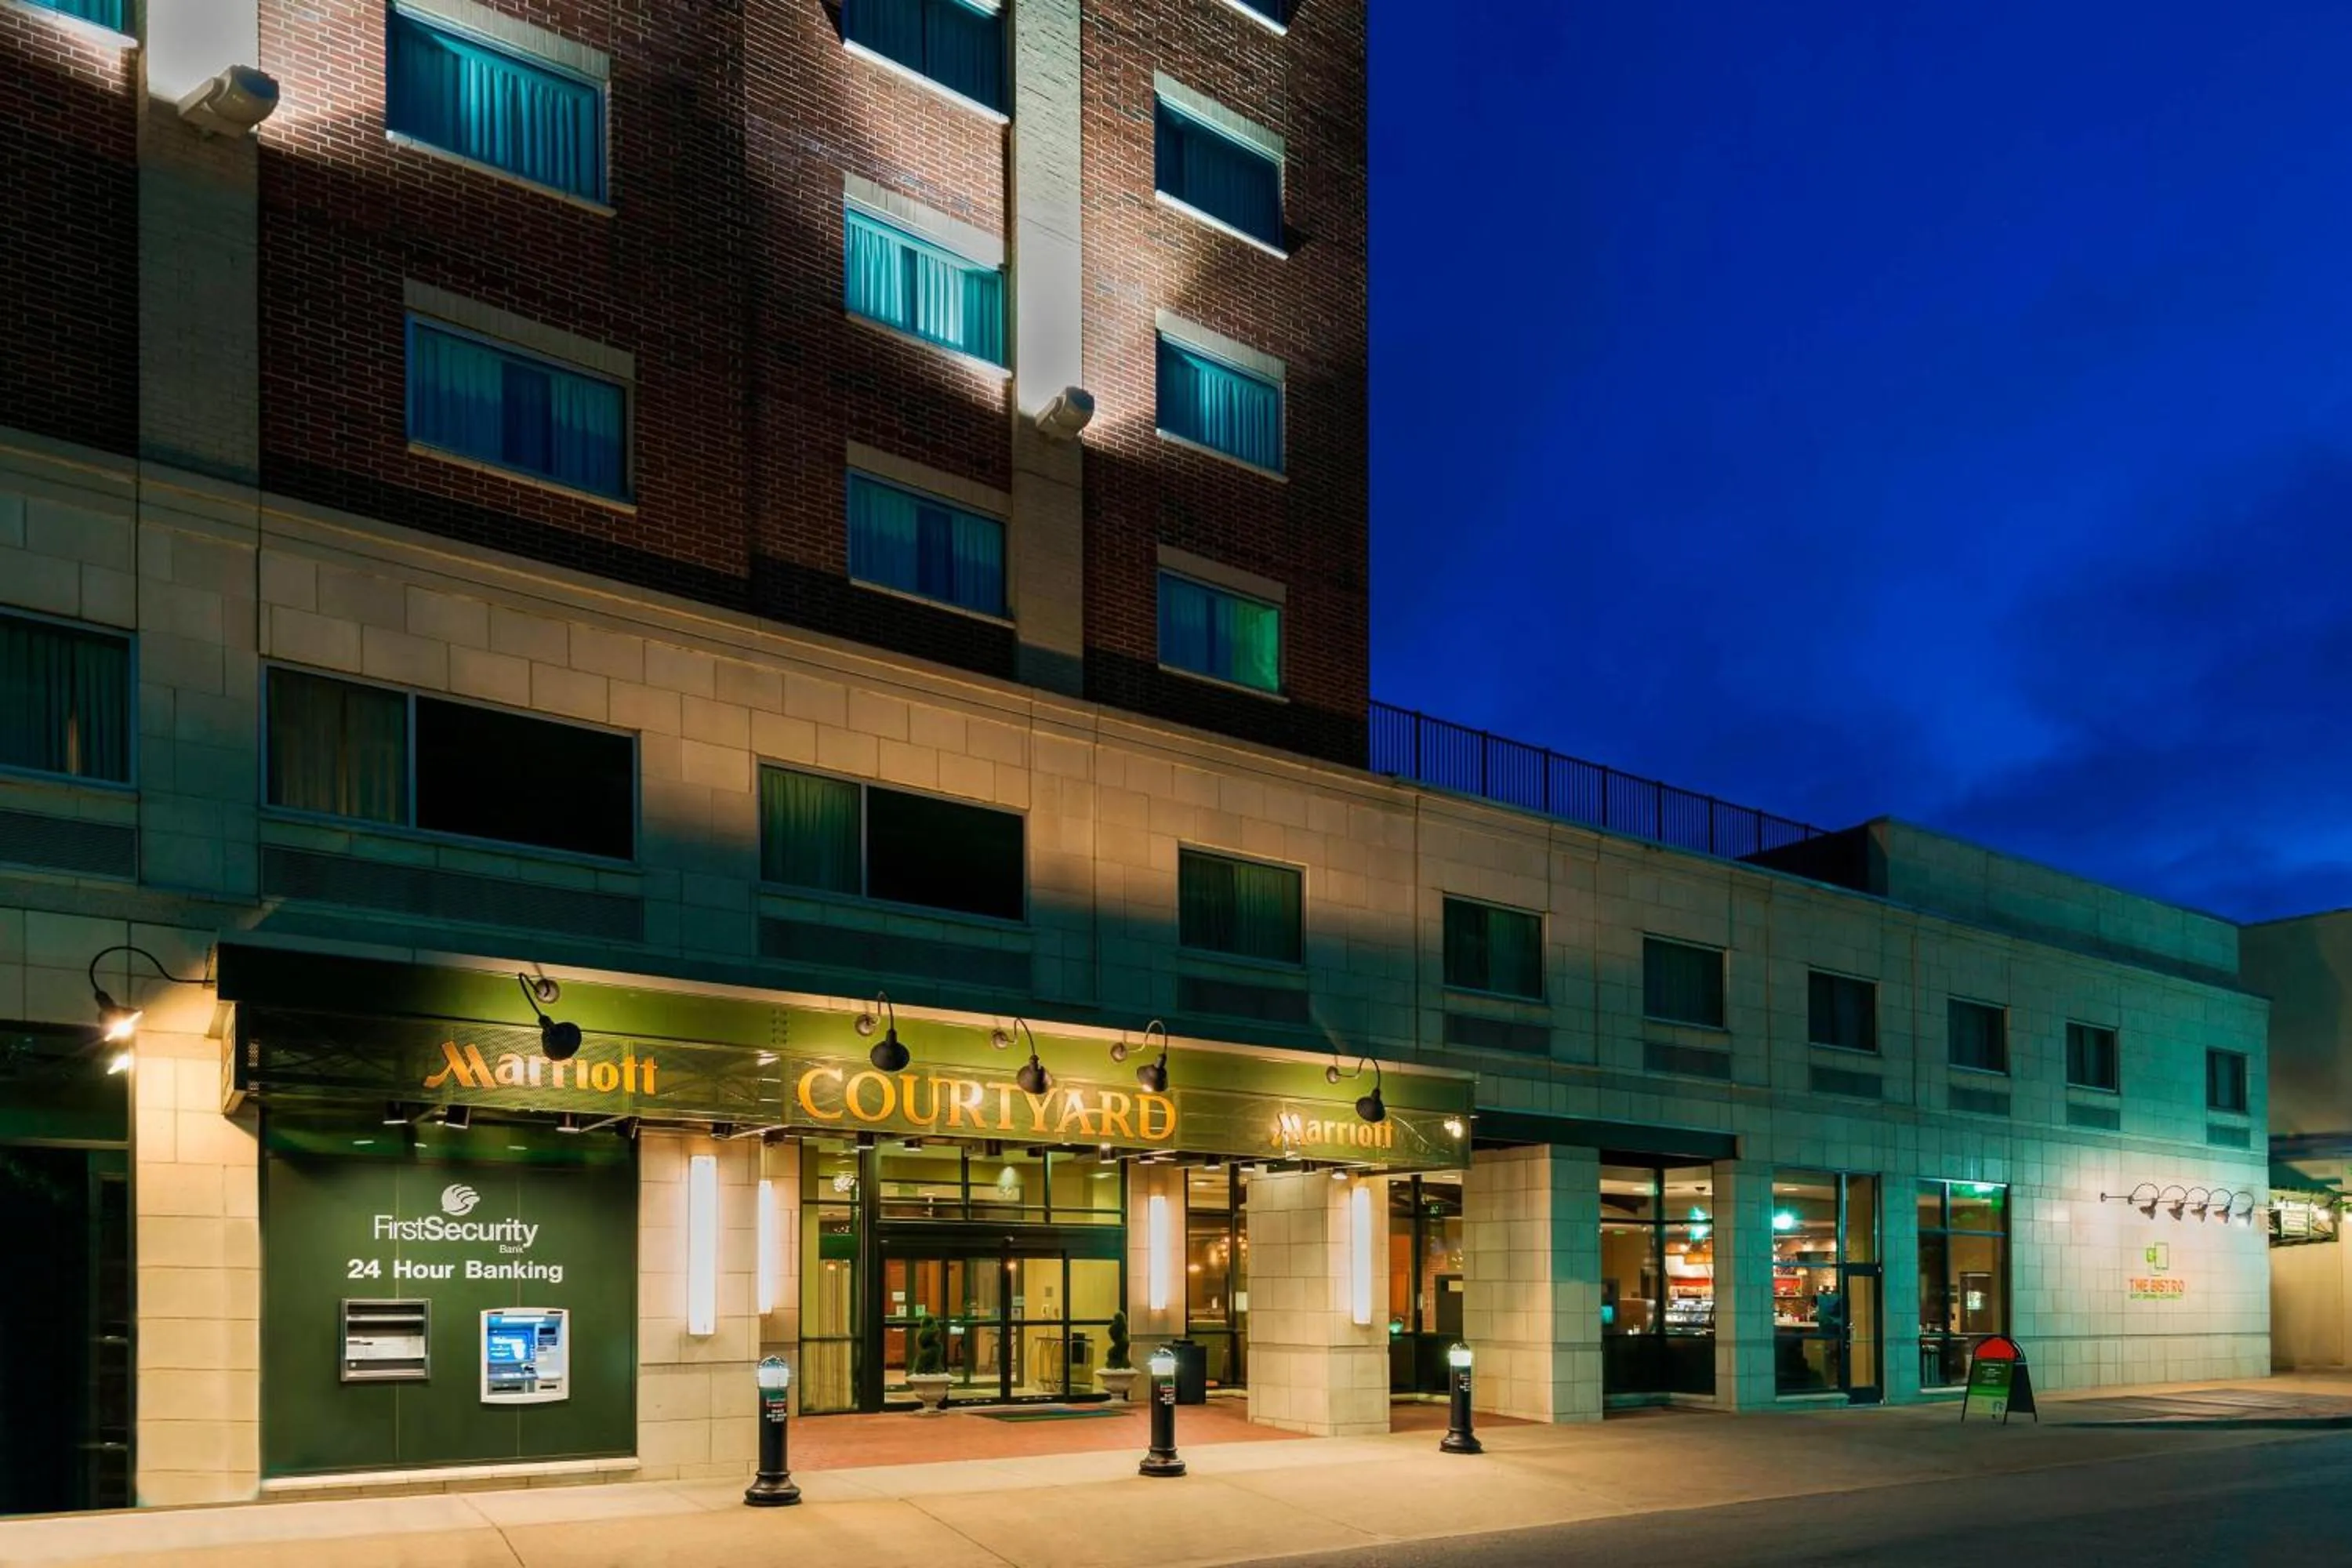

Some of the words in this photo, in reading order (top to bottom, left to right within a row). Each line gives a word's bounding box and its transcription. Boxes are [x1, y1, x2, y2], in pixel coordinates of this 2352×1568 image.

[423, 1040, 659, 1094] Marriott
[797, 1067, 1176, 1141] COURTYARD
[1271, 1112, 1393, 1149] Marriott
[373, 1214, 539, 1247] FirstSecurity
[499, 1244, 524, 1254] Bank
[347, 1259, 382, 1279] 24
[394, 1259, 455, 1279] Hour
[465, 1260, 563, 1283] Banking
